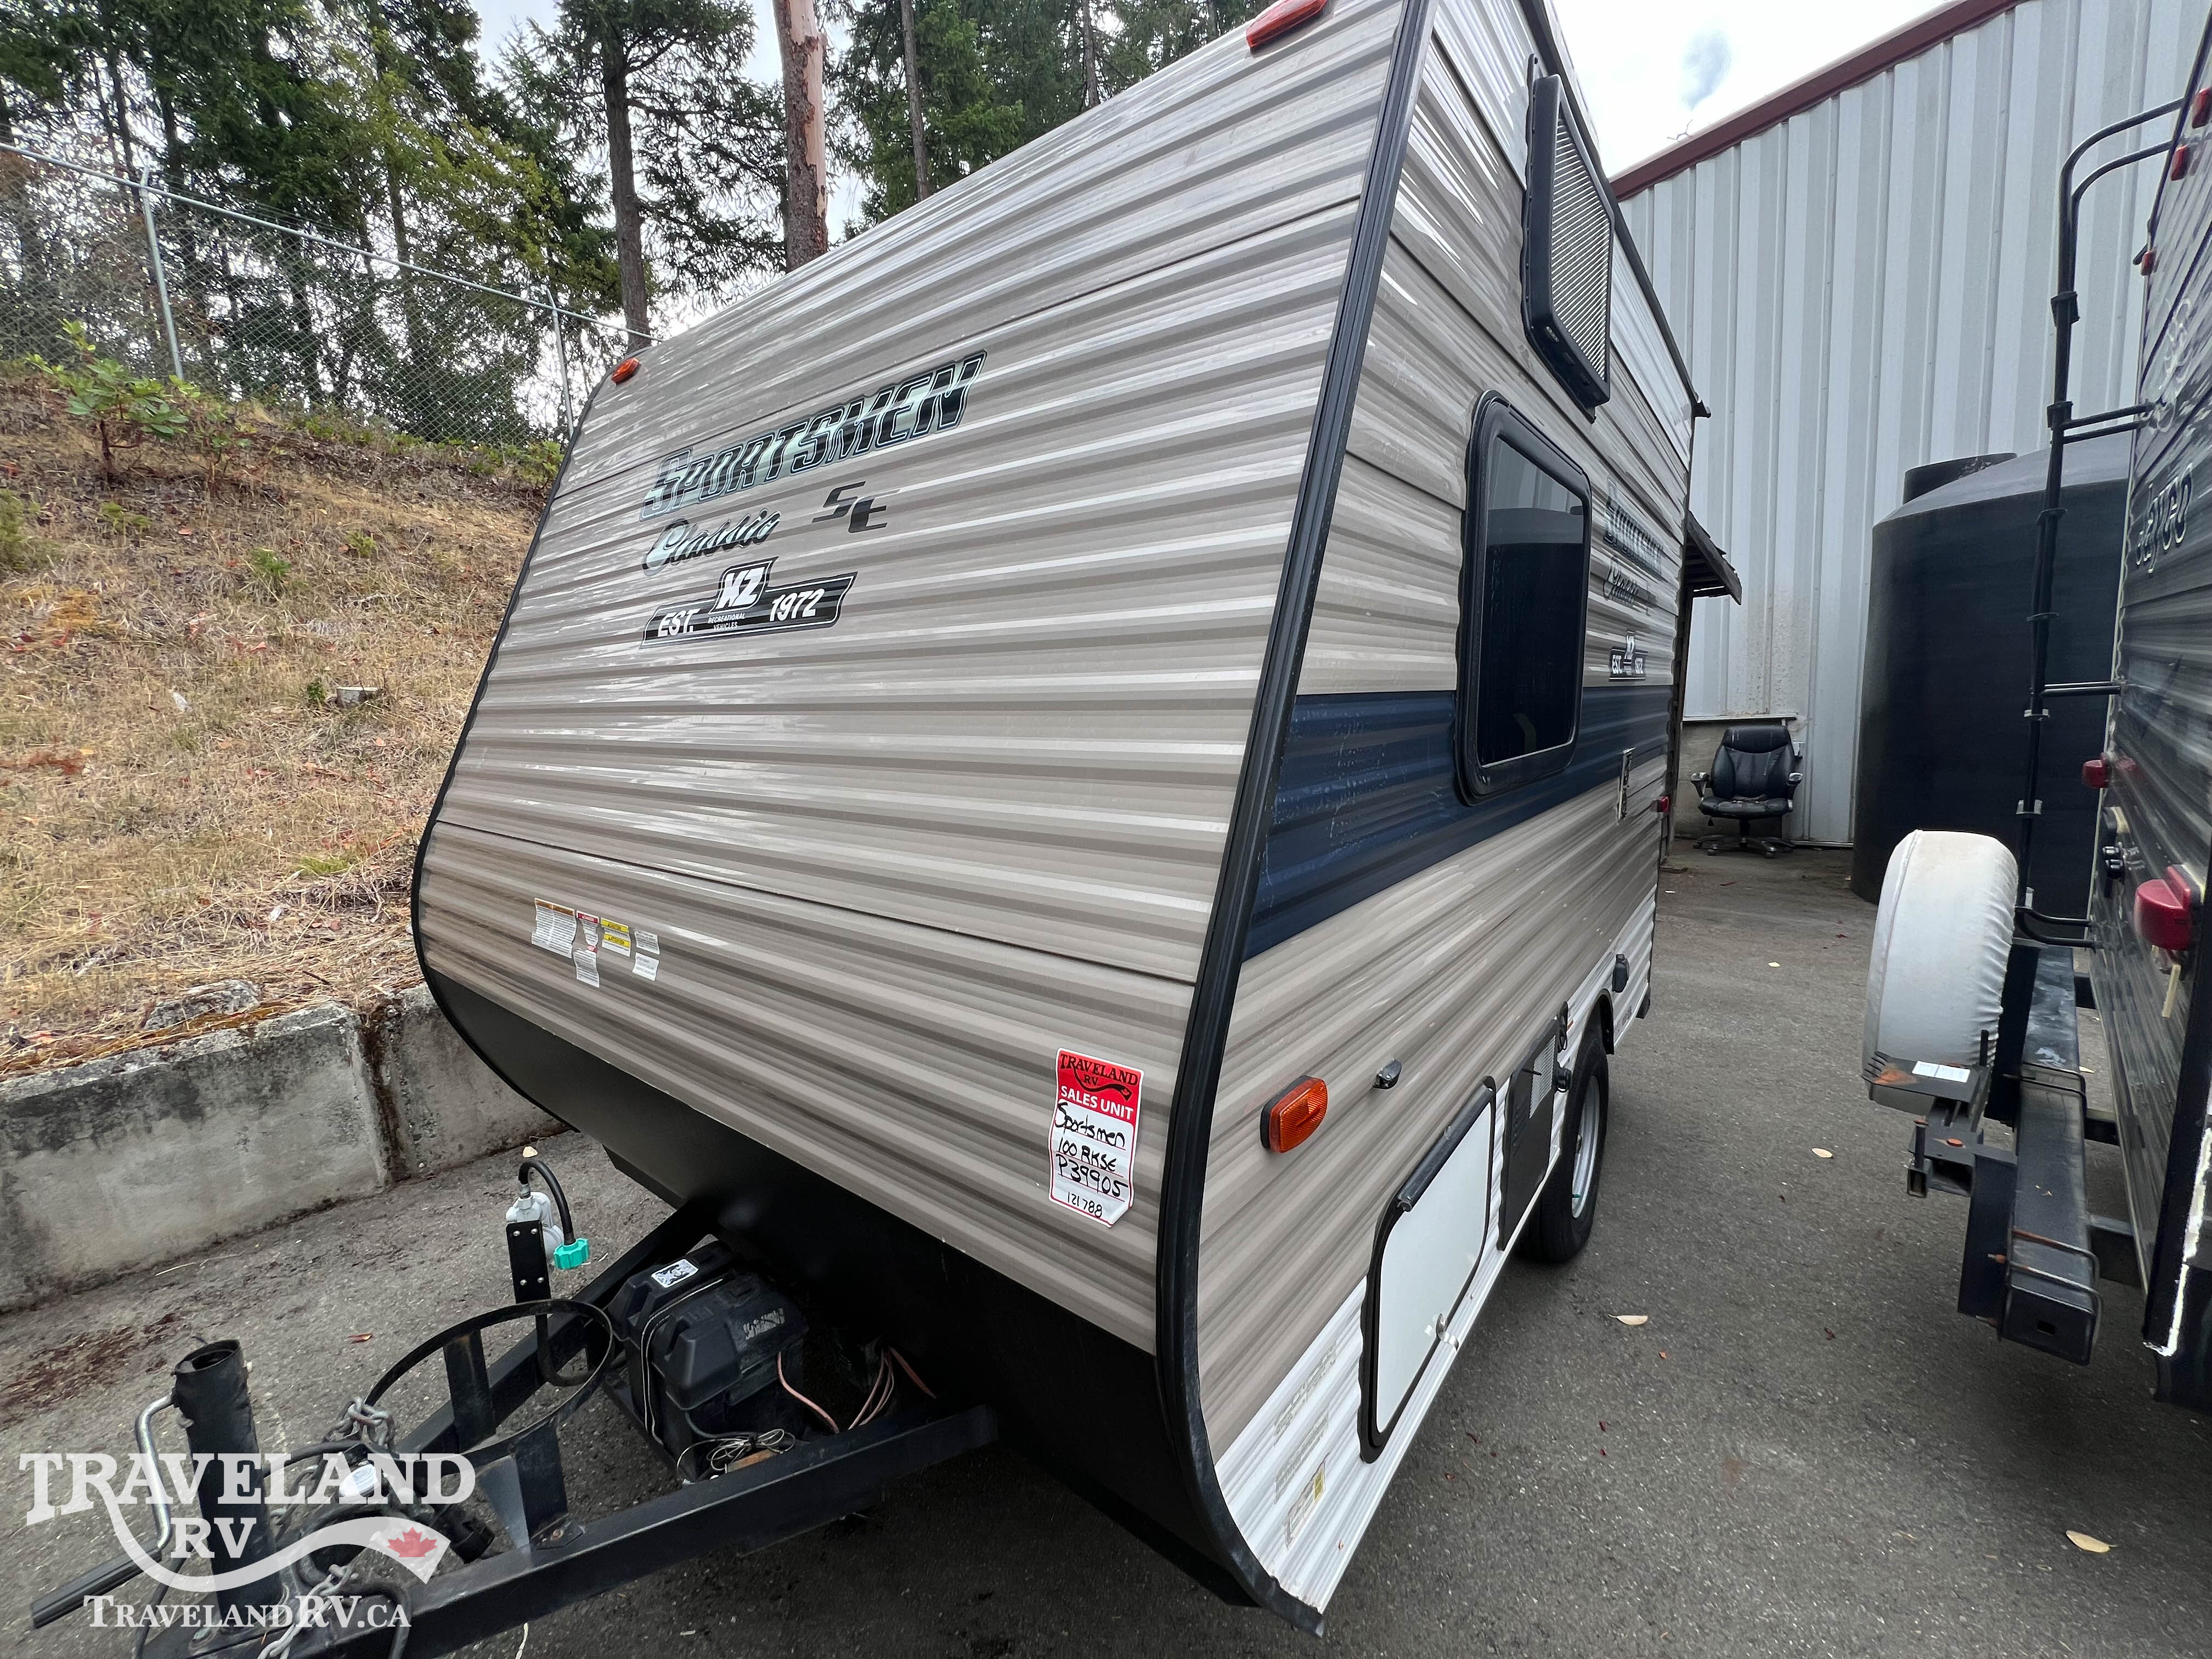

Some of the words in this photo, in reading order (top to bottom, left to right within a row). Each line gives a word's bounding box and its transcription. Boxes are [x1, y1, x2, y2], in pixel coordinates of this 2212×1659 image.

[641, 351, 987, 518] SPORTSMEN
[642, 508, 781, 576] Classic
[717, 566, 765, 610] KZ
[657, 607, 701, 637] EST.
[769, 588, 826, 622] 1972
[708, 612, 746, 624] RECREATIONAL
[713, 622, 738, 631] VEHICLES
[1059, 1053, 1138, 1086] TRAVELAND
[1083, 1075, 1099, 1087] RV
[1055, 1102, 1126, 1148] Sportsmen
[1060, 1086, 1098, 1109] SALES
[1101, 1100, 1134, 1121] UNIT
[1056, 1154, 1128, 1197] P39905
